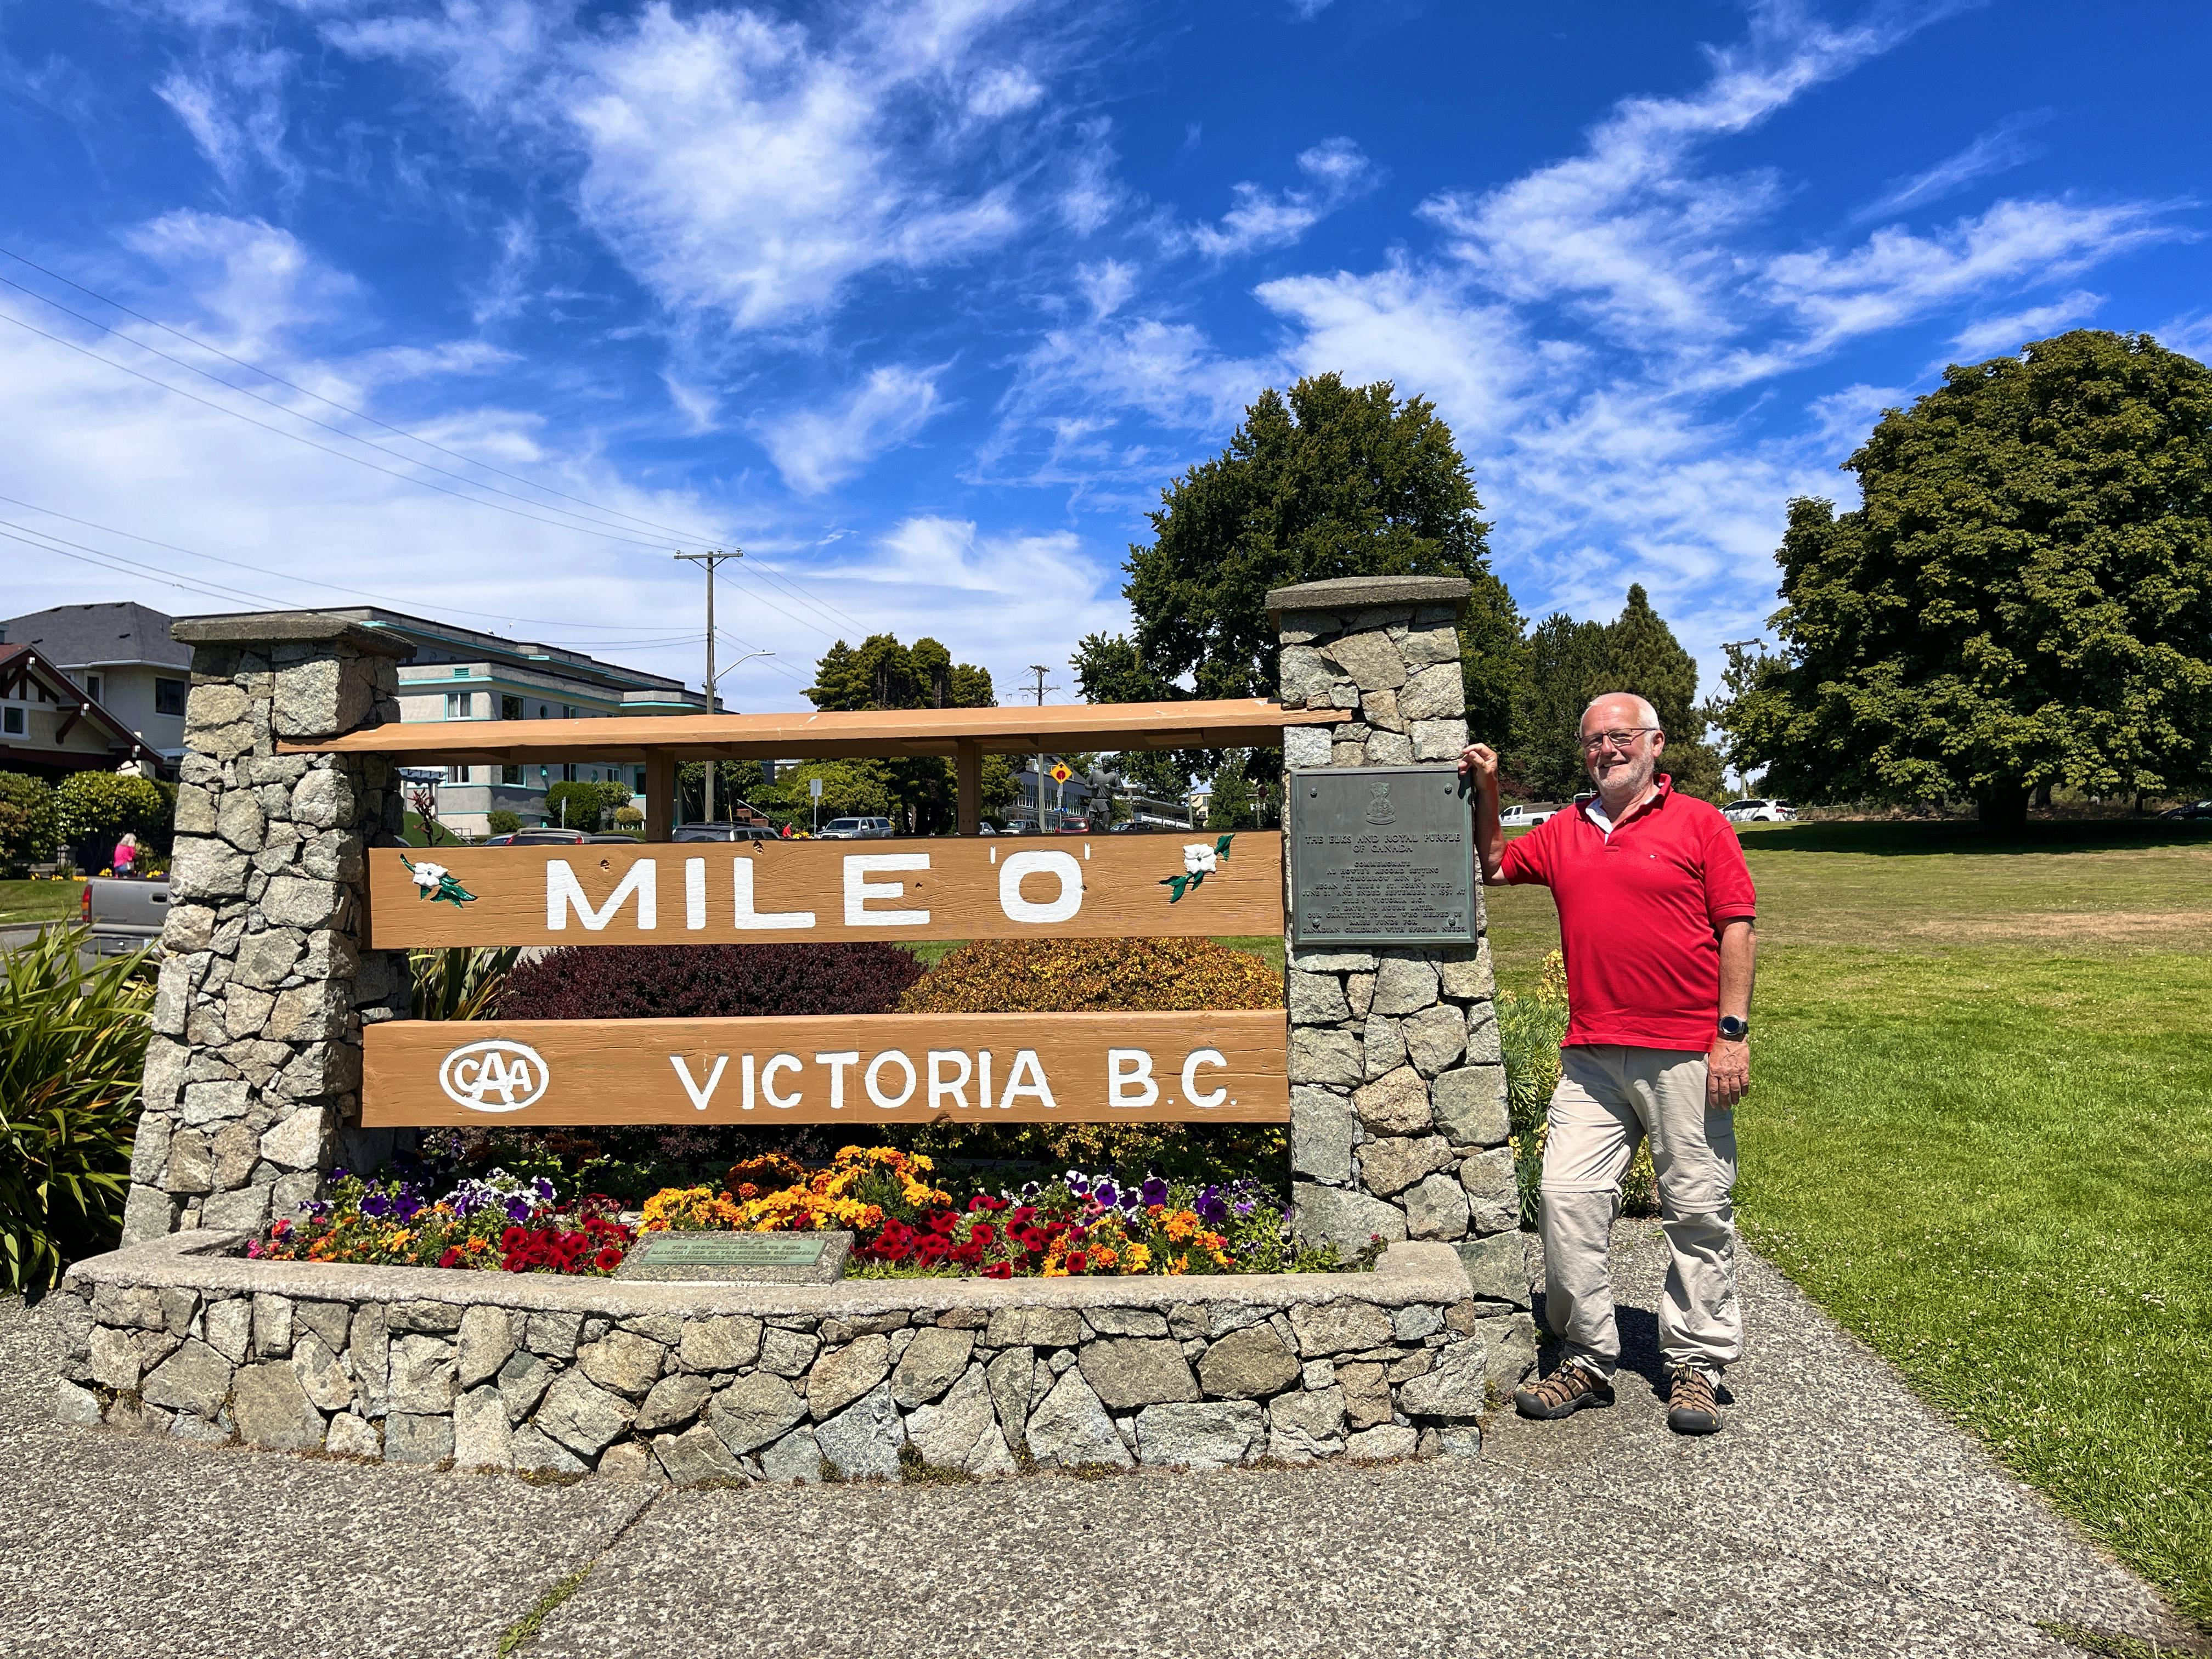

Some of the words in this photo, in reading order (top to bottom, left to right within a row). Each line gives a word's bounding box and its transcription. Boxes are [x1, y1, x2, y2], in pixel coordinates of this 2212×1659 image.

[1305, 835, 1323, 844] THE
[1329, 834, 1351, 844] ELKS
[1357, 834, 1379, 843] AND
[1384, 834, 1418, 843] ROYAL
[1424, 833, 1460, 842] PURPLE
[1352, 844, 1364, 853] OF
[1372, 844, 1413, 853] CANADA
[547, 853, 930, 930] MILE
[454, 1050, 533, 1103] CAA
[669, 1047, 1057, 1110] VICTORIA
[1108, 1047, 1237, 1108] B.C.
